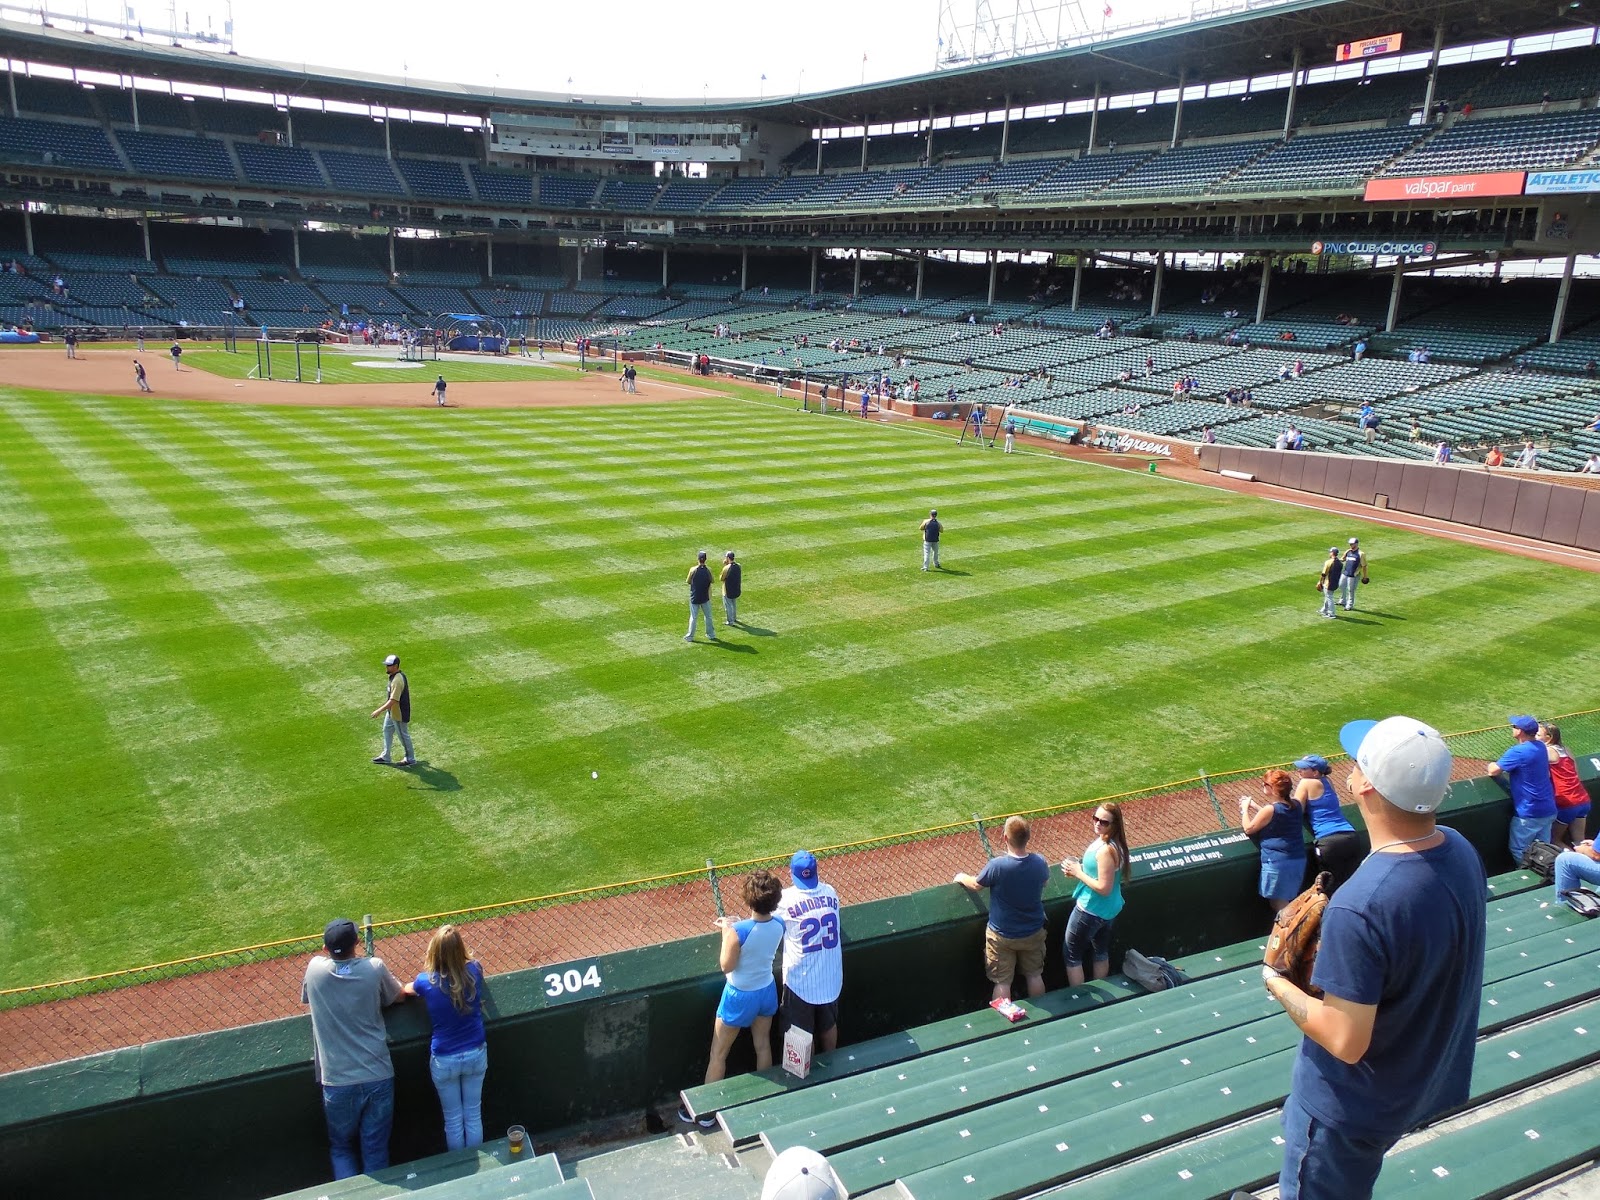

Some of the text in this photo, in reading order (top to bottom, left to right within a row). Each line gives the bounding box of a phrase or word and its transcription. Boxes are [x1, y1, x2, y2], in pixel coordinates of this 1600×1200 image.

[1405, 179, 1477, 198] valspar paint
[1323, 243, 1346, 254] PNC
[1346, 242, 1376, 254] CLUB
[1099, 429, 1172, 456] lgreens
[1128, 854, 1143, 863] her
[1142, 852, 1159, 860] fans
[1159, 849, 1172, 857] are
[1170, 845, 1183, 855] the
[1183, 840, 1212, 853] greatest
[1210, 838, 1220, 847] in
[1150, 850, 1224, 871] Let's keep it that way.
[787, 895, 838, 919] SANDBERG
[799, 912, 839, 954] 23
[543, 964, 602, 997] 304
